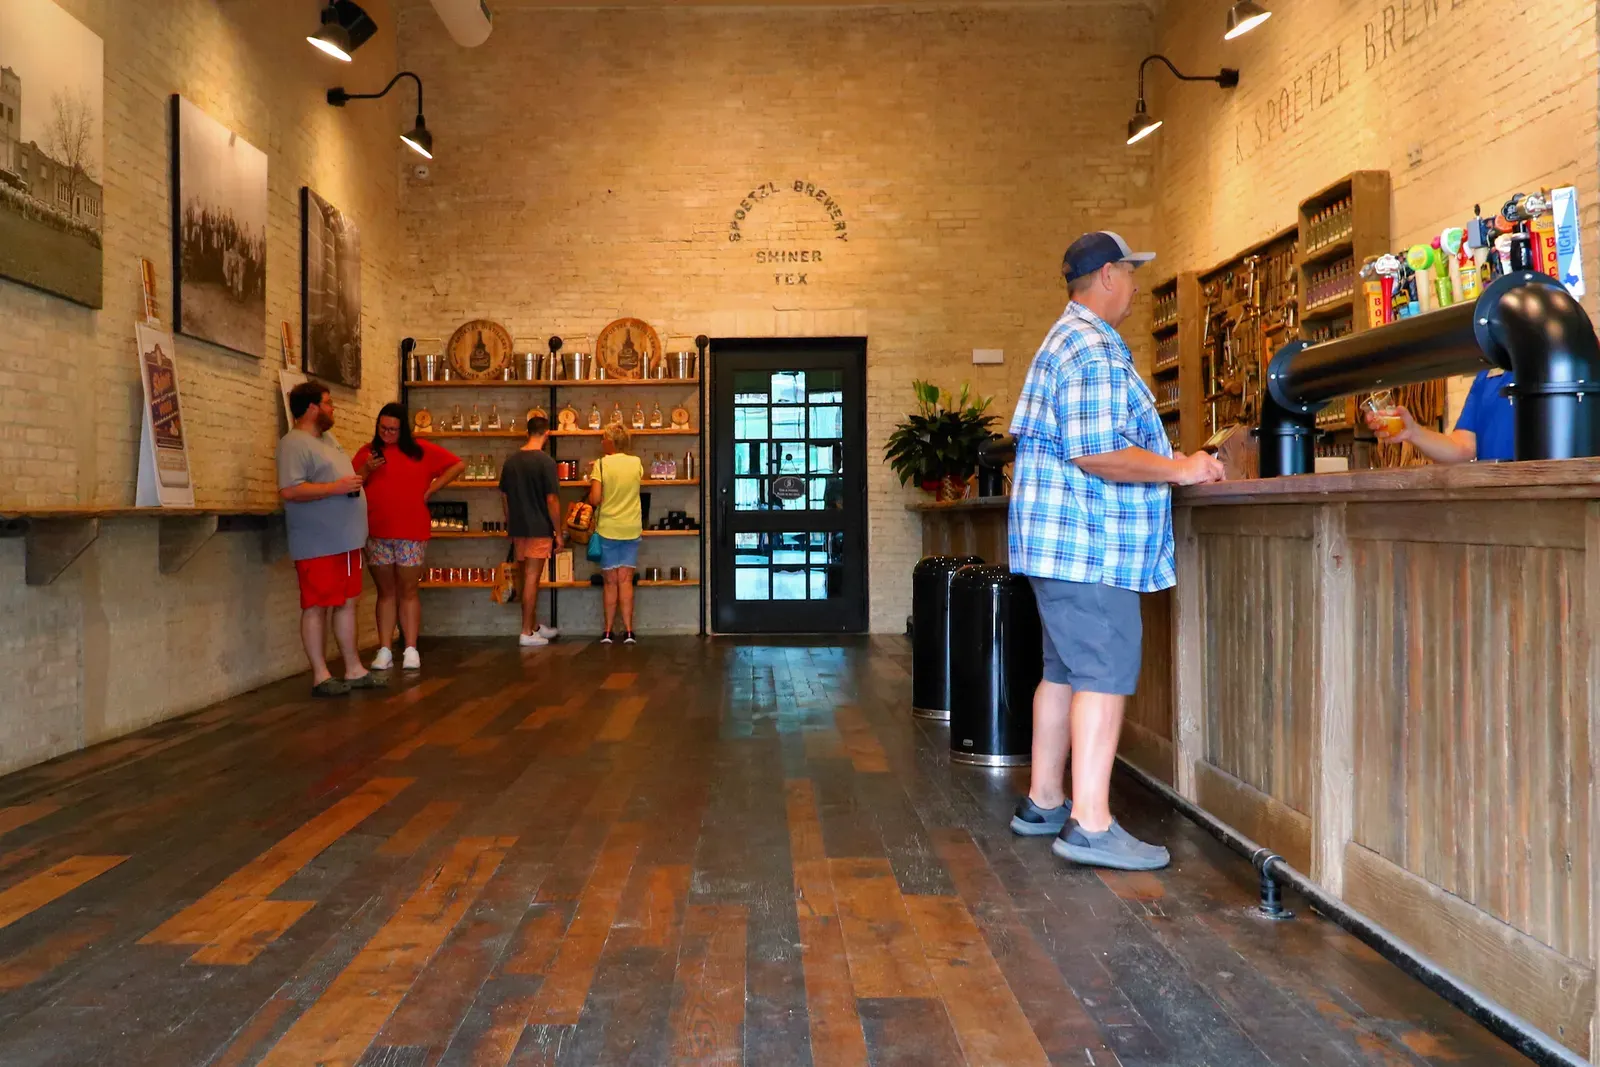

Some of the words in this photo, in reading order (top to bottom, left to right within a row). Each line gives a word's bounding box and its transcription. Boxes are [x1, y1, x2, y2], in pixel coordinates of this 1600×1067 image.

[1254, 45, 1350, 151] SPOETZL
[729, 182, 780, 243] SPOETZL
[793, 180, 848, 242] BREWERY
[756, 250, 822, 264] SHINER
[1545, 236, 1558, 278] BOC
[1557, 225, 1573, 256] LIGHT
[774, 273, 808, 286] TEX
